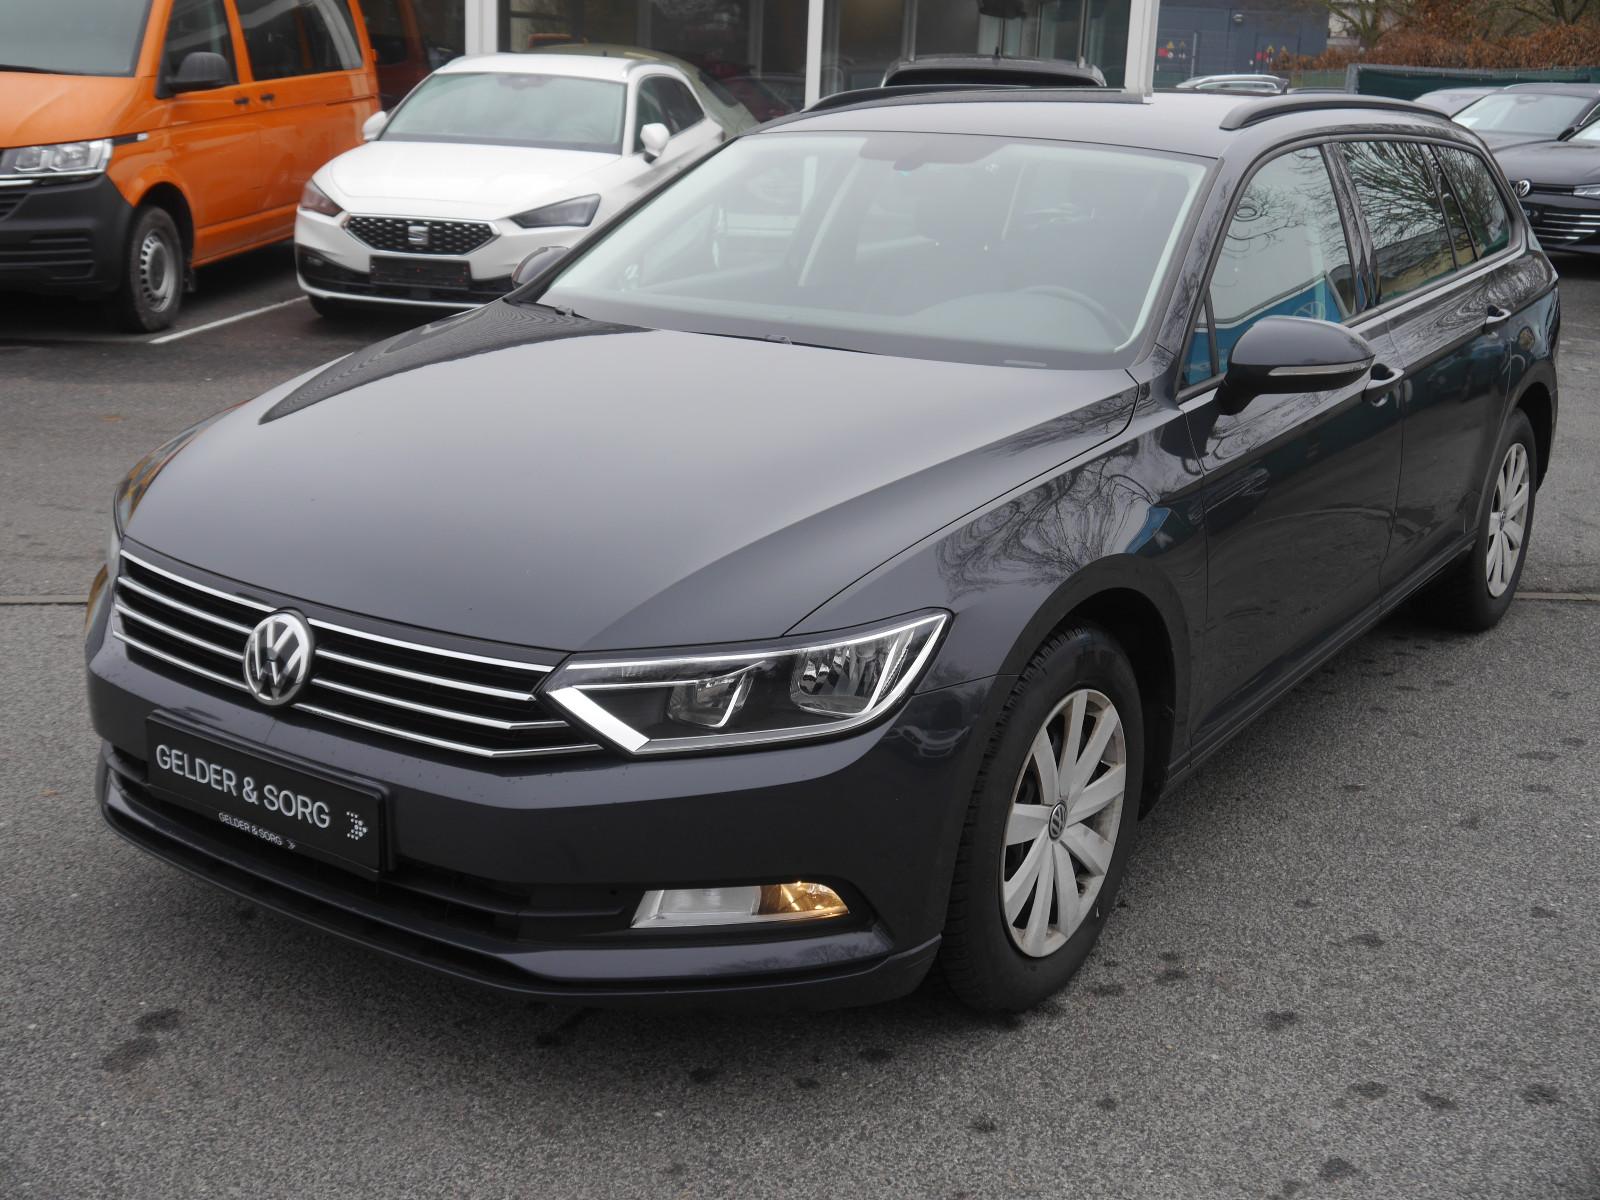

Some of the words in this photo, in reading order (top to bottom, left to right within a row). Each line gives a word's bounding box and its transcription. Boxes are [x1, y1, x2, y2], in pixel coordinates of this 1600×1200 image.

[156, 744, 238, 797] GELDER
[242, 776, 259, 805] &
[263, 784, 331, 829] SORG
[218, 812, 251, 833] GELDER
[251, 824, 259, 836] &
[258, 828, 283, 846] SORG
